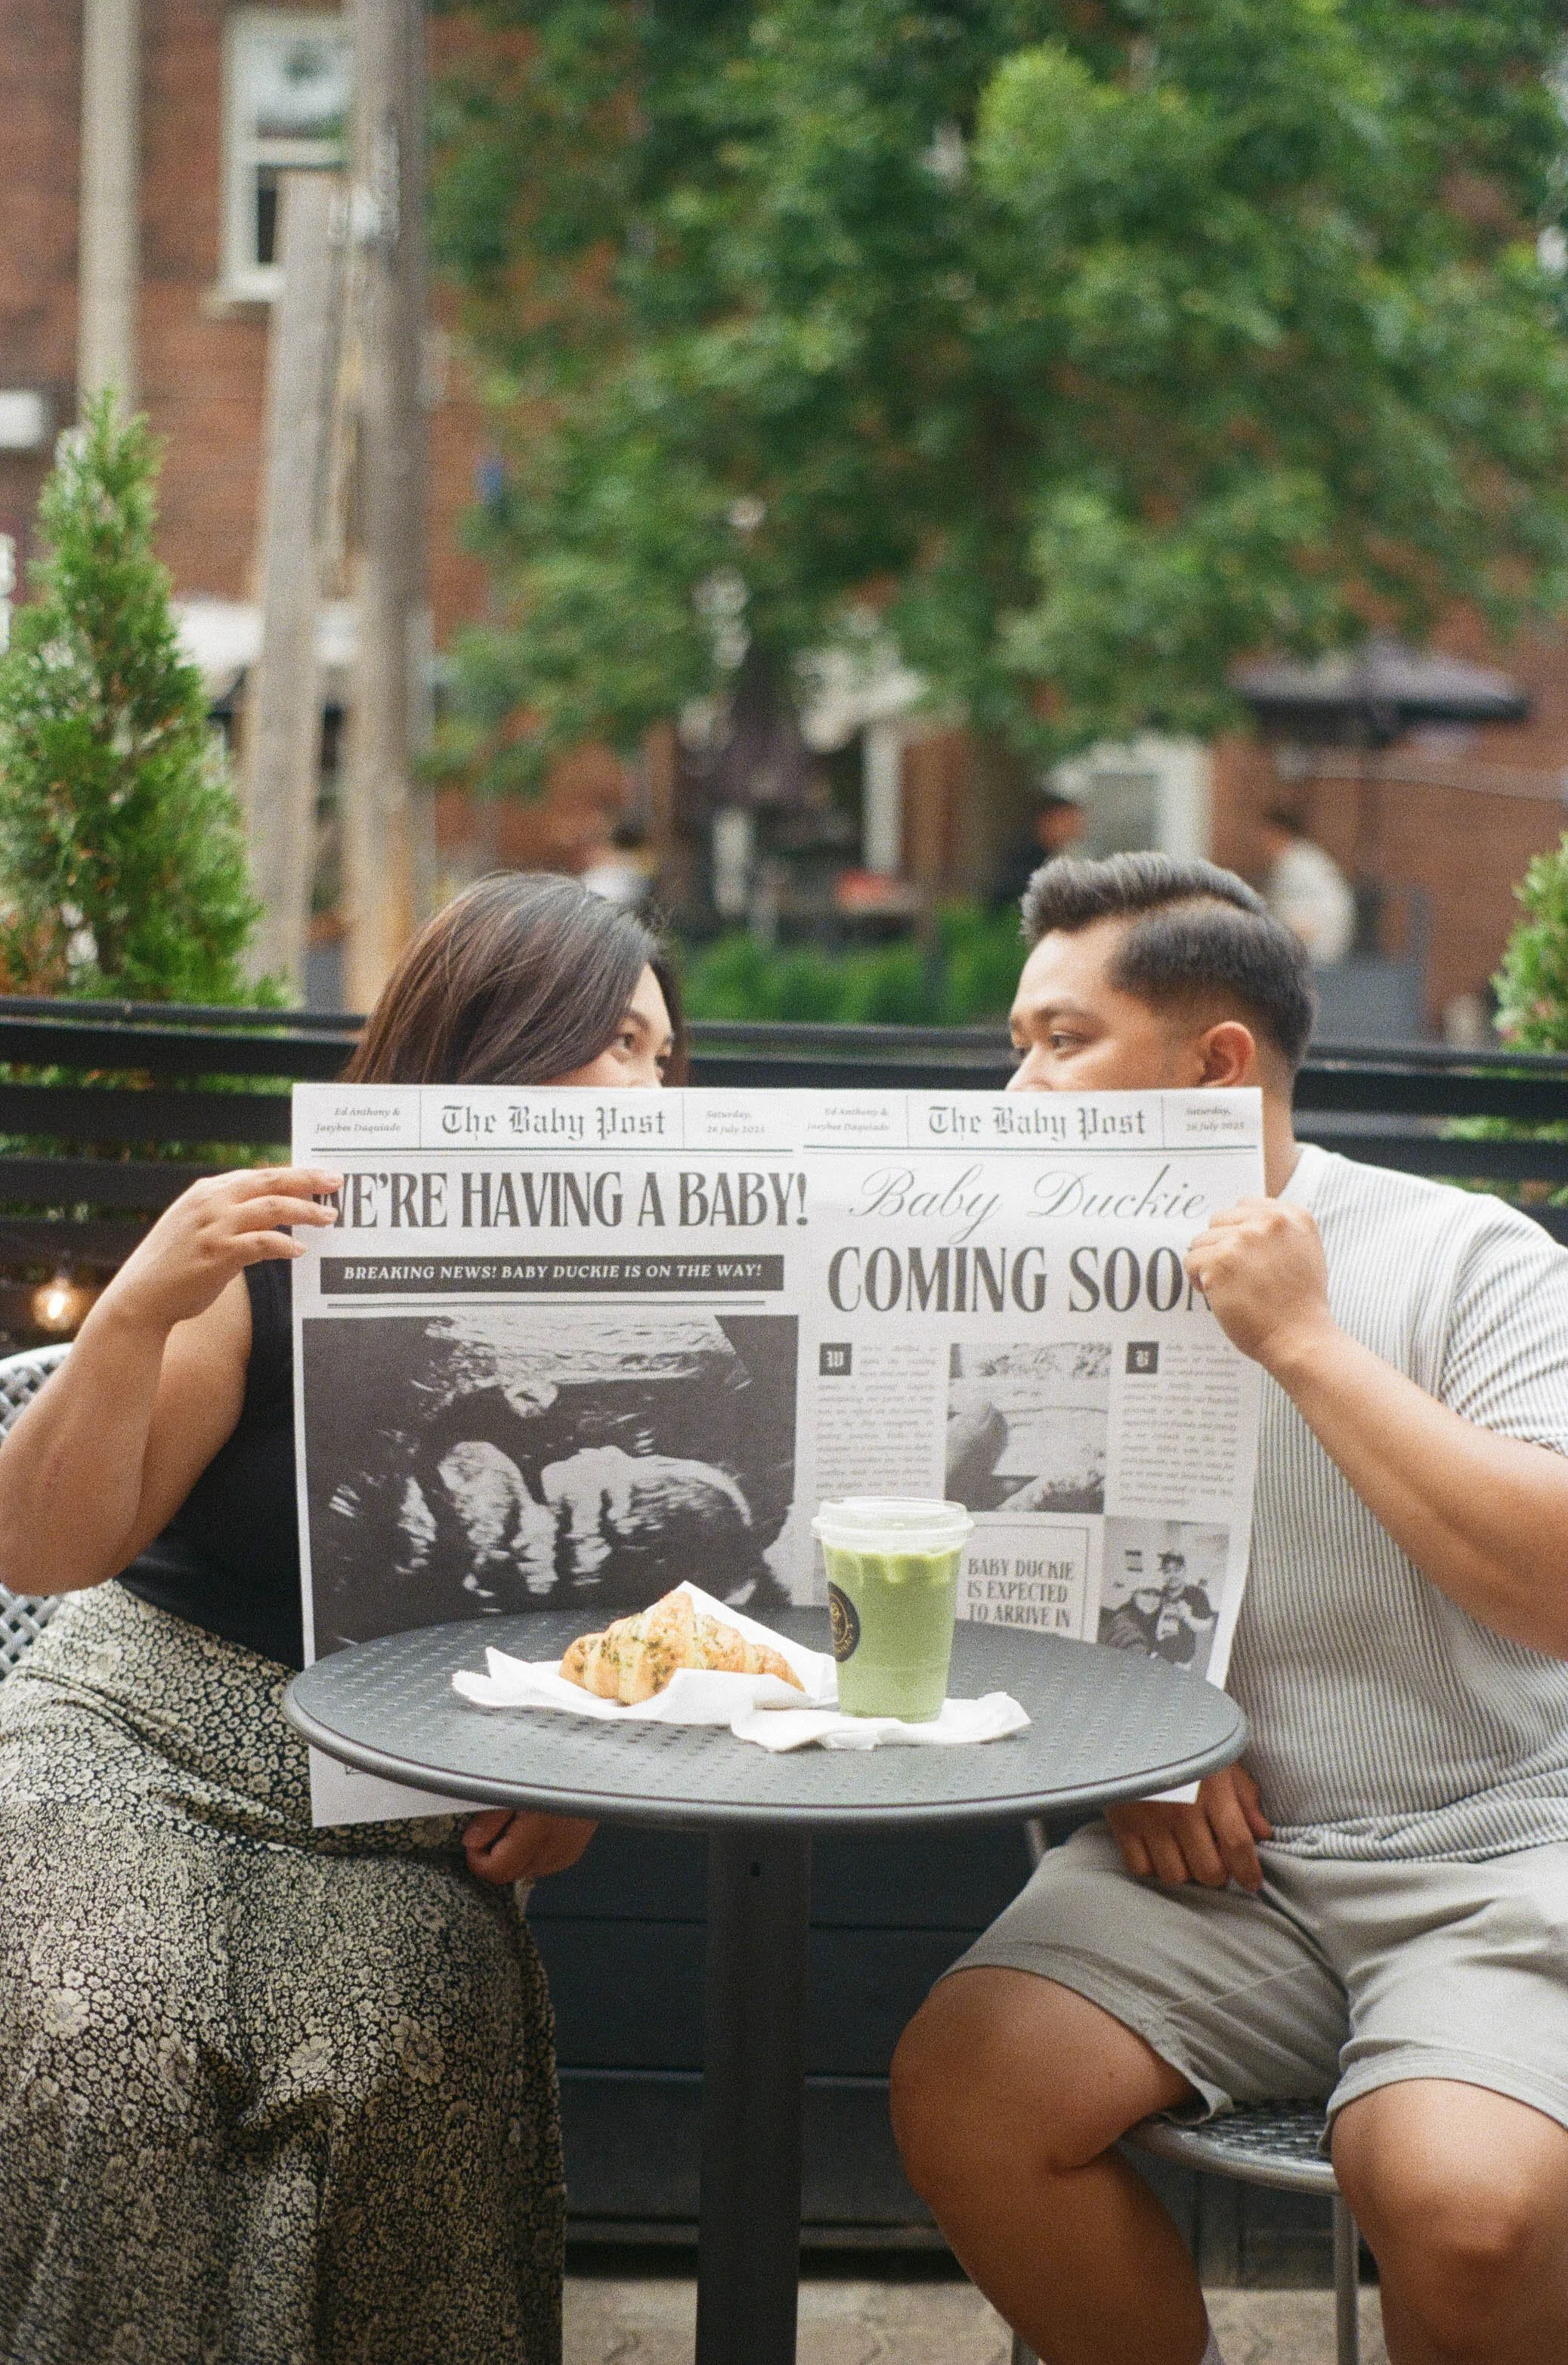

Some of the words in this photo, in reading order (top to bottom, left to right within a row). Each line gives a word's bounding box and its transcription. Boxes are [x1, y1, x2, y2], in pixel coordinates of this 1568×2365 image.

[349, 1107, 391, 1118] Anthony
[441, 1105, 497, 1140] The
[508, 1105, 585, 1140] Baby
[595, 1106, 665, 1140] Post
[929, 1105, 982, 1142] The
[992, 1106, 1067, 1142] Baby
[1076, 1107, 1146, 1140] Post
[460, 1171, 623, 1228] HAVING
[637, 1172, 666, 1227] A
[678, 1171, 809, 1227] BABY!
[848, 1164, 1003, 1244] Baby
[1026, 1164, 1211, 1219] Duckie
[343, 1266, 435, 1280] BREAKING
[439, 1265, 496, 1279] NEWS!
[500, 1265, 548, 1278] BABY
[552, 1264, 620, 1278] DUCKIE
[624, 1264, 642, 1278] IS
[645, 1264, 673, 1278] ON
[676, 1264, 711, 1278] THE
[716, 1263, 762, 1277] WAY!
[827, 1246, 1048, 1313] COMING
[967, 1558, 1009, 1576] BABY
[1015, 1559, 1074, 1581] DUCKIE
[966, 1579, 982, 1598] IS
[987, 1580, 1068, 1603] EXPECTED
[967, 1602, 989, 1621] TO
[993, 1603, 1050, 1626] ARRIVE
[1054, 1606, 1071, 1628] IN
